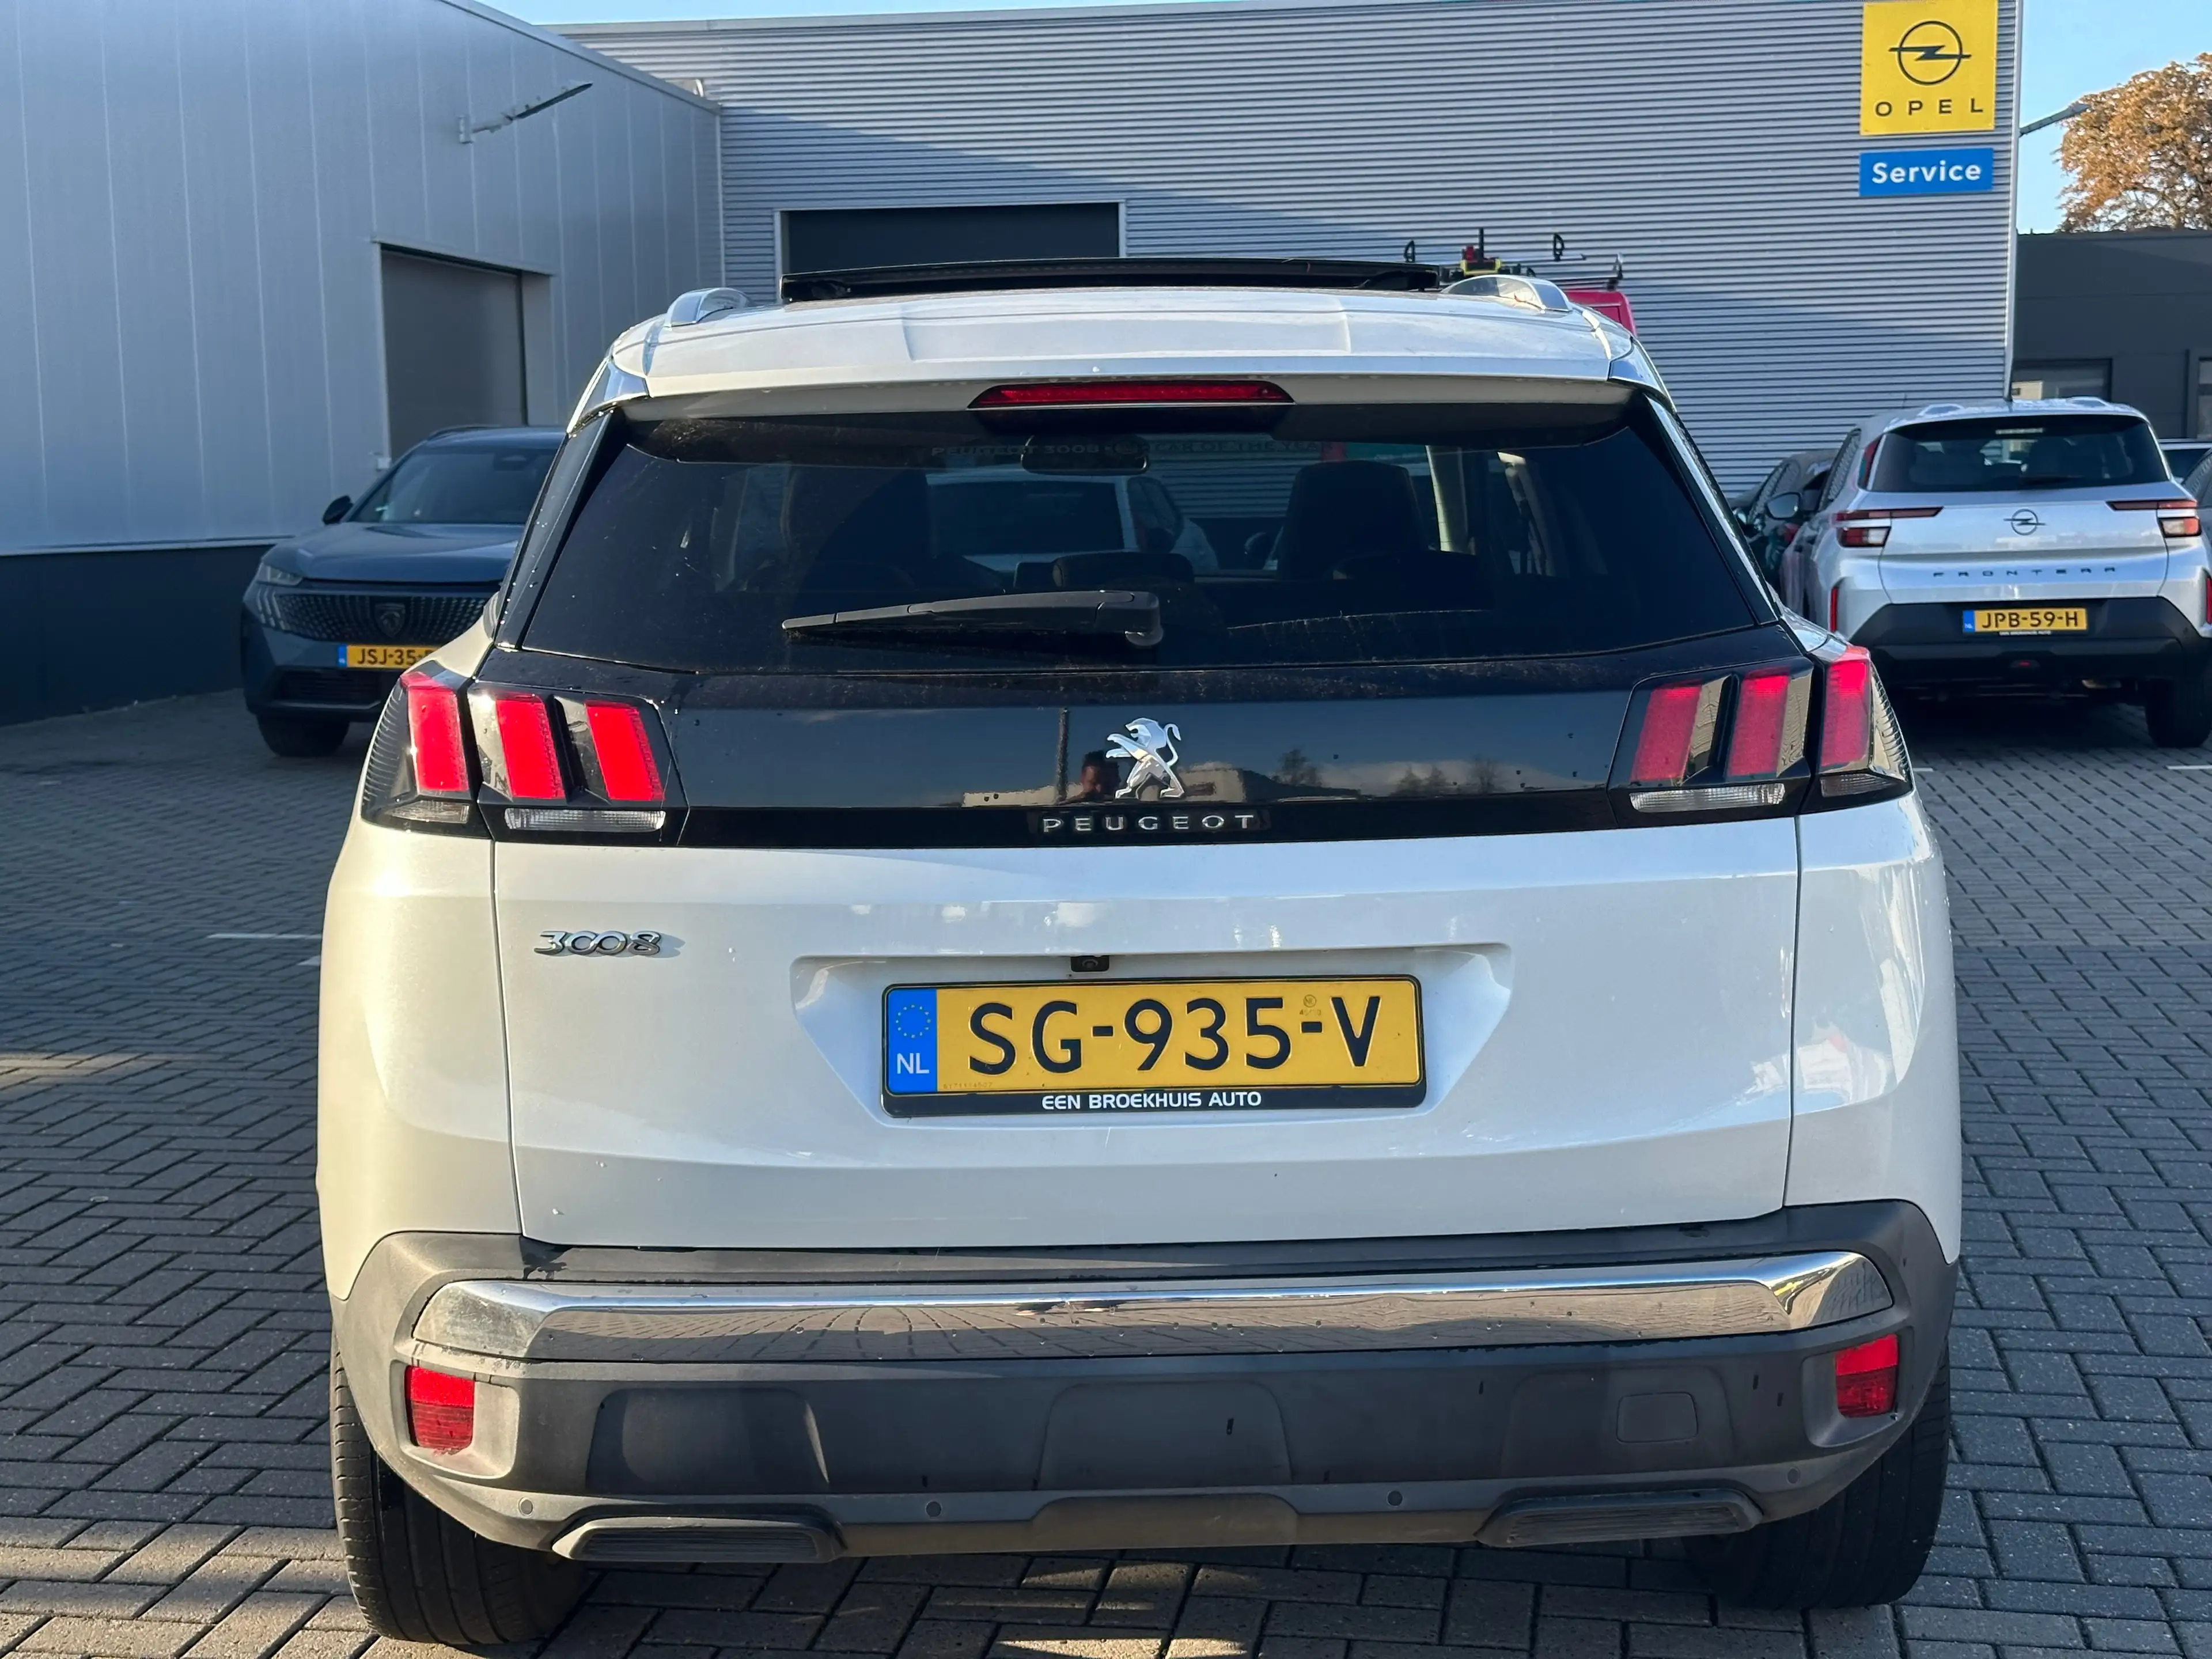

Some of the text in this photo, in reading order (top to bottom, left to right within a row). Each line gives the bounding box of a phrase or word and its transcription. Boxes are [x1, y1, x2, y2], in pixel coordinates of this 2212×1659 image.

[1875, 98, 1983, 117] OPEL
[1872, 160, 1981, 184] Service
[1982, 611, 2078, 628] JPB-59-H
[1043, 815, 1254, 832] PEUGEOT
[533, 930, 662, 956] 3008
[968, 996, 1381, 1075] SG-935-V
[897, 1053, 929, 1074] NL
[1042, 1092, 1262, 1109] EEN BROEKHUIS AUTO
